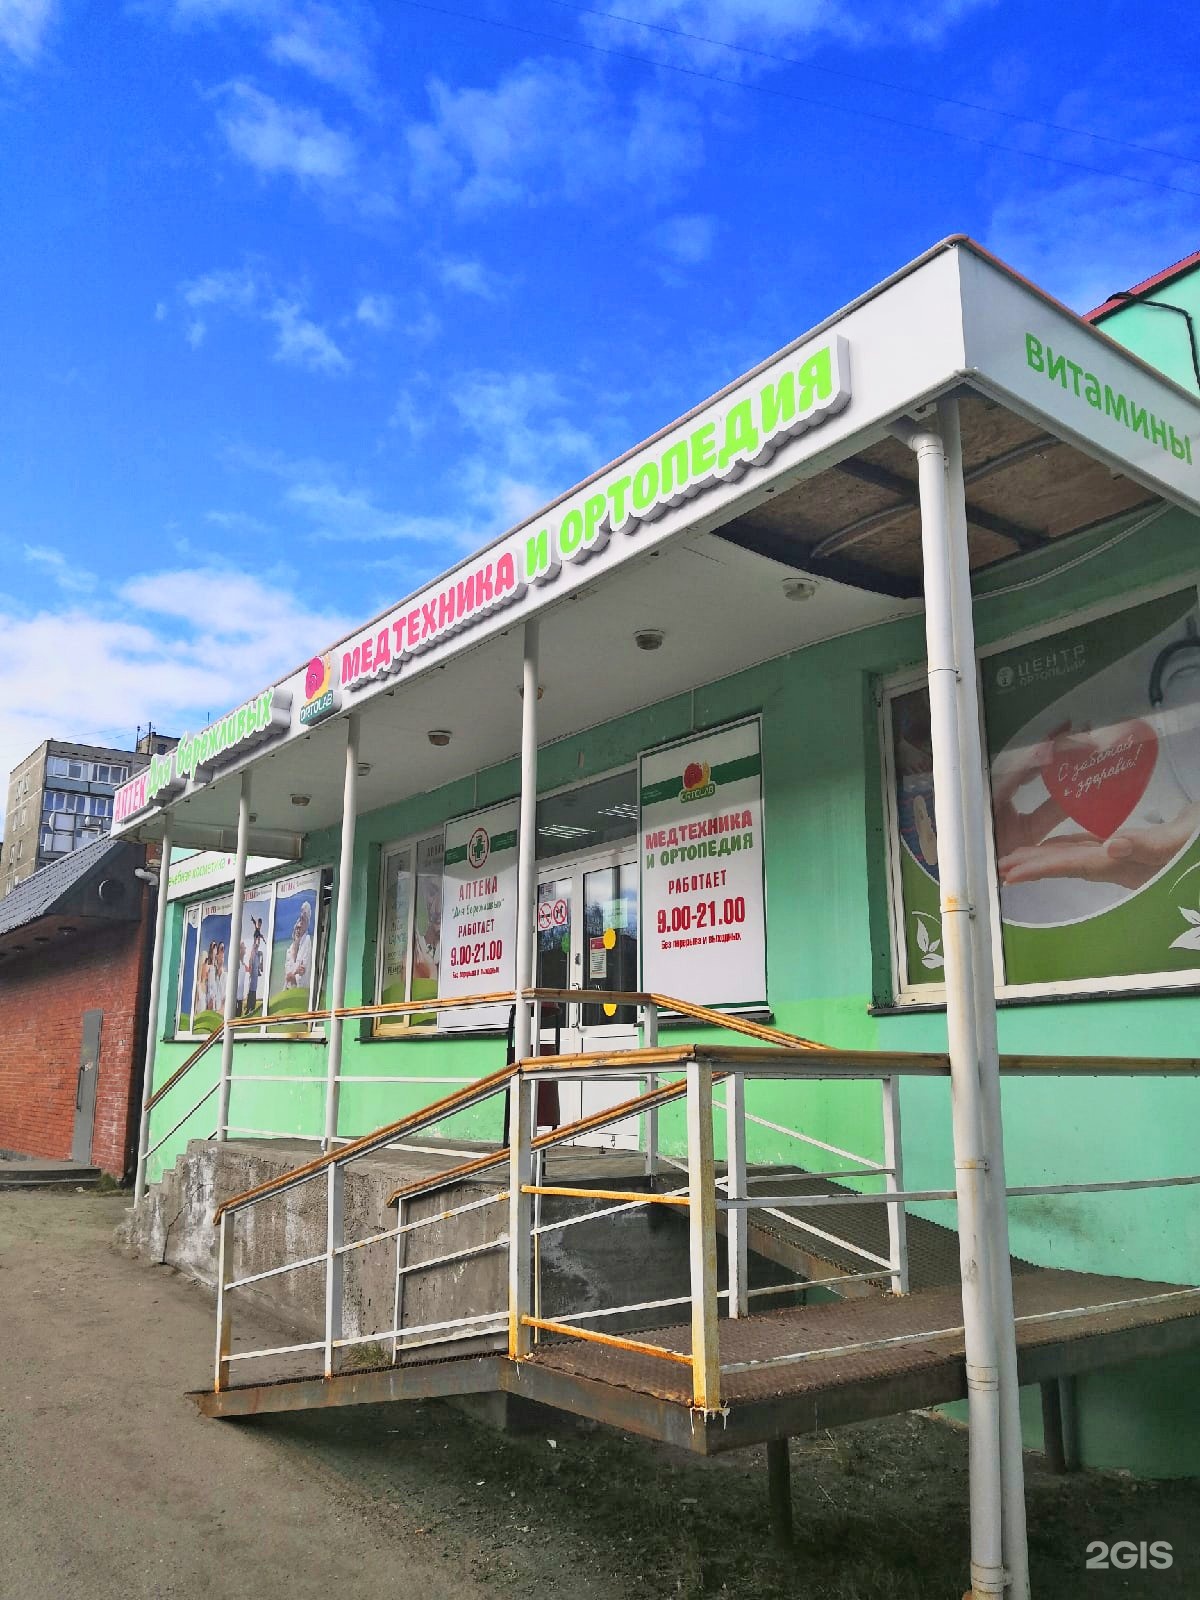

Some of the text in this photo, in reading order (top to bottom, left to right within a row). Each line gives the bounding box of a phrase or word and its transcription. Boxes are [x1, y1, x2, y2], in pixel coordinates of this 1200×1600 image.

[1025, 332, 1193, 465] витамины
[341, 346, 834, 684] МЕДТЕХНИКА И ОРТОПЕДИЯ
[1018, 643, 1085, 677] ЦЕНТР
[300, 693, 333, 722] ORTOLAB
[115, 774, 147, 822] АПТЕК
[645, 809, 753, 850] МЕДТЕХНИКА
[646, 832, 753, 870] И ОРТОПЕДИЯ
[458, 875, 499, 901] АПТЕКА
[668, 869, 727, 895] РАБОТАЕТ
[458, 918, 495, 939] РАБОТАЕТ
[657, 896, 746, 934] 9.00-21.00
[450, 939, 503, 967] 9.00-21.00
